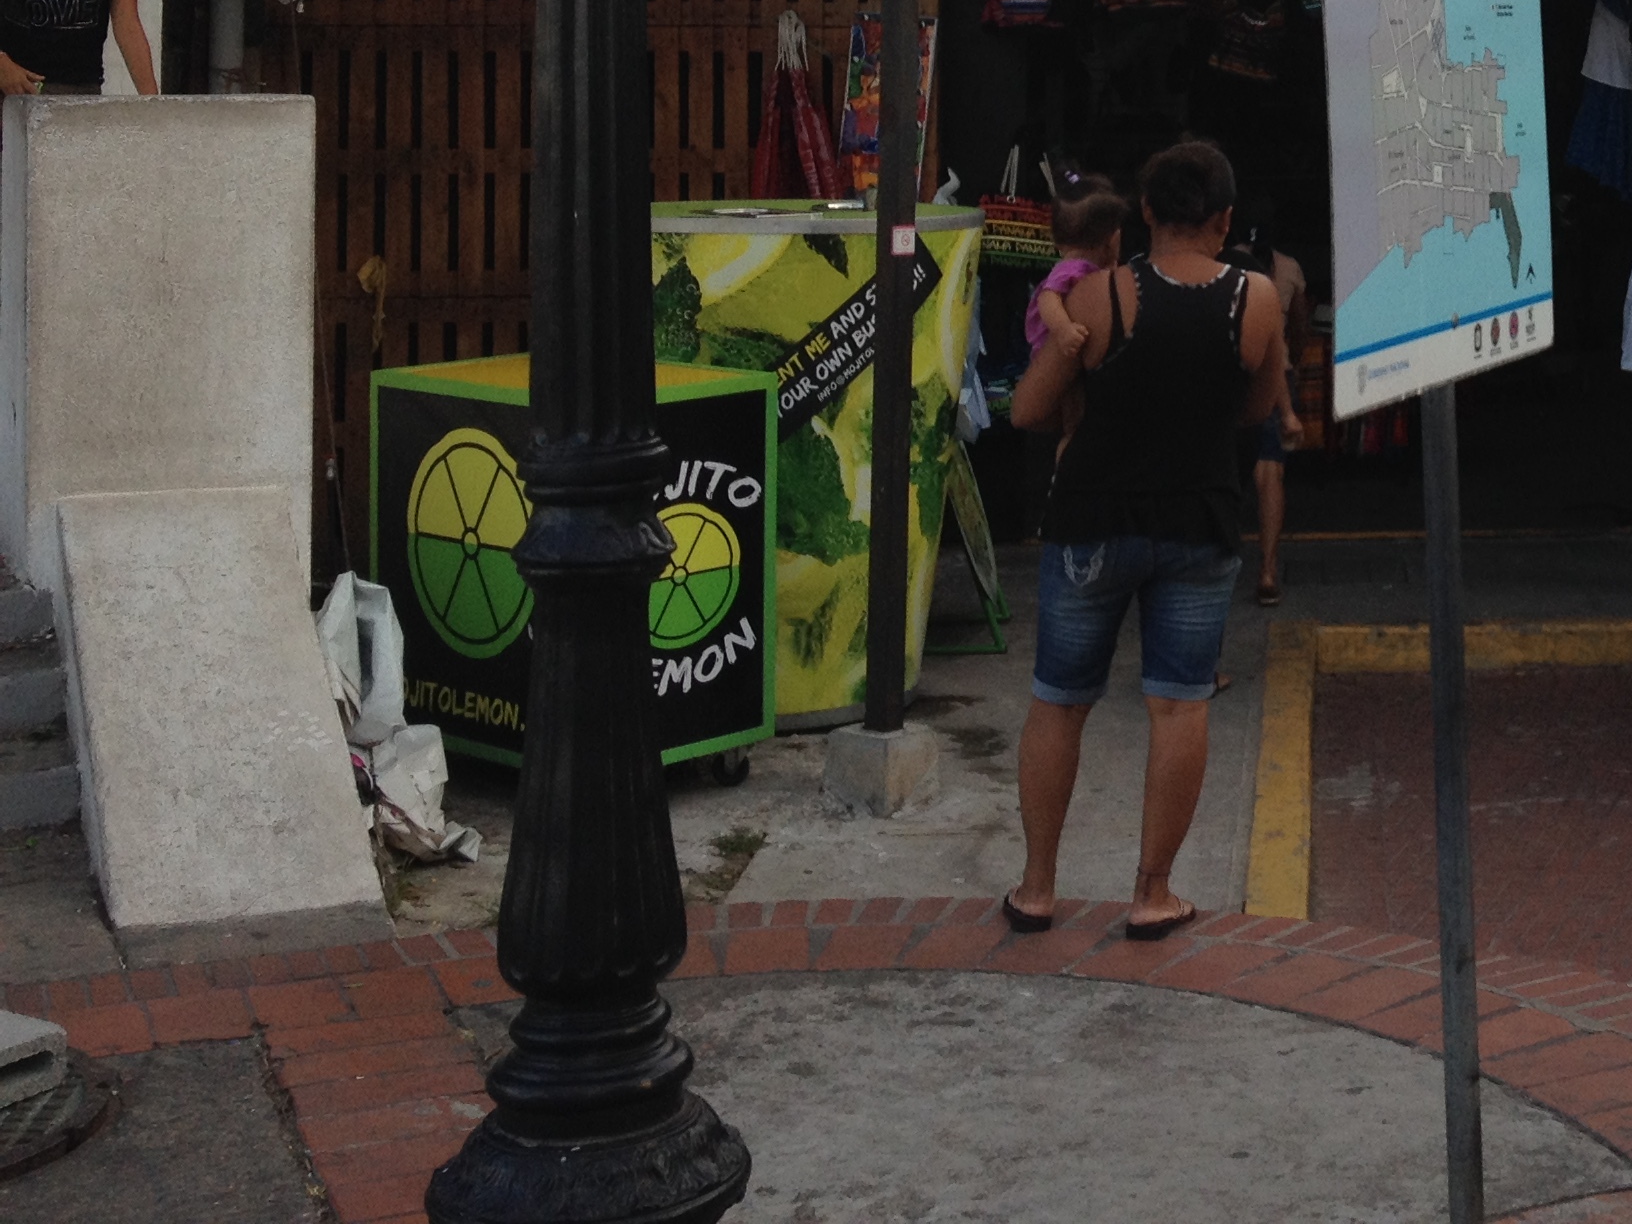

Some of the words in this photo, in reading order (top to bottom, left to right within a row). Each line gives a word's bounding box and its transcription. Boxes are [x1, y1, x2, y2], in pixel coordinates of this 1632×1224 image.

[804, 332, 831, 361] ME
[830, 302, 865, 339] AND
[778, 376, 819, 418] OUR
[816, 341, 853, 380] OWN
[653, 460, 762, 508] JITO
